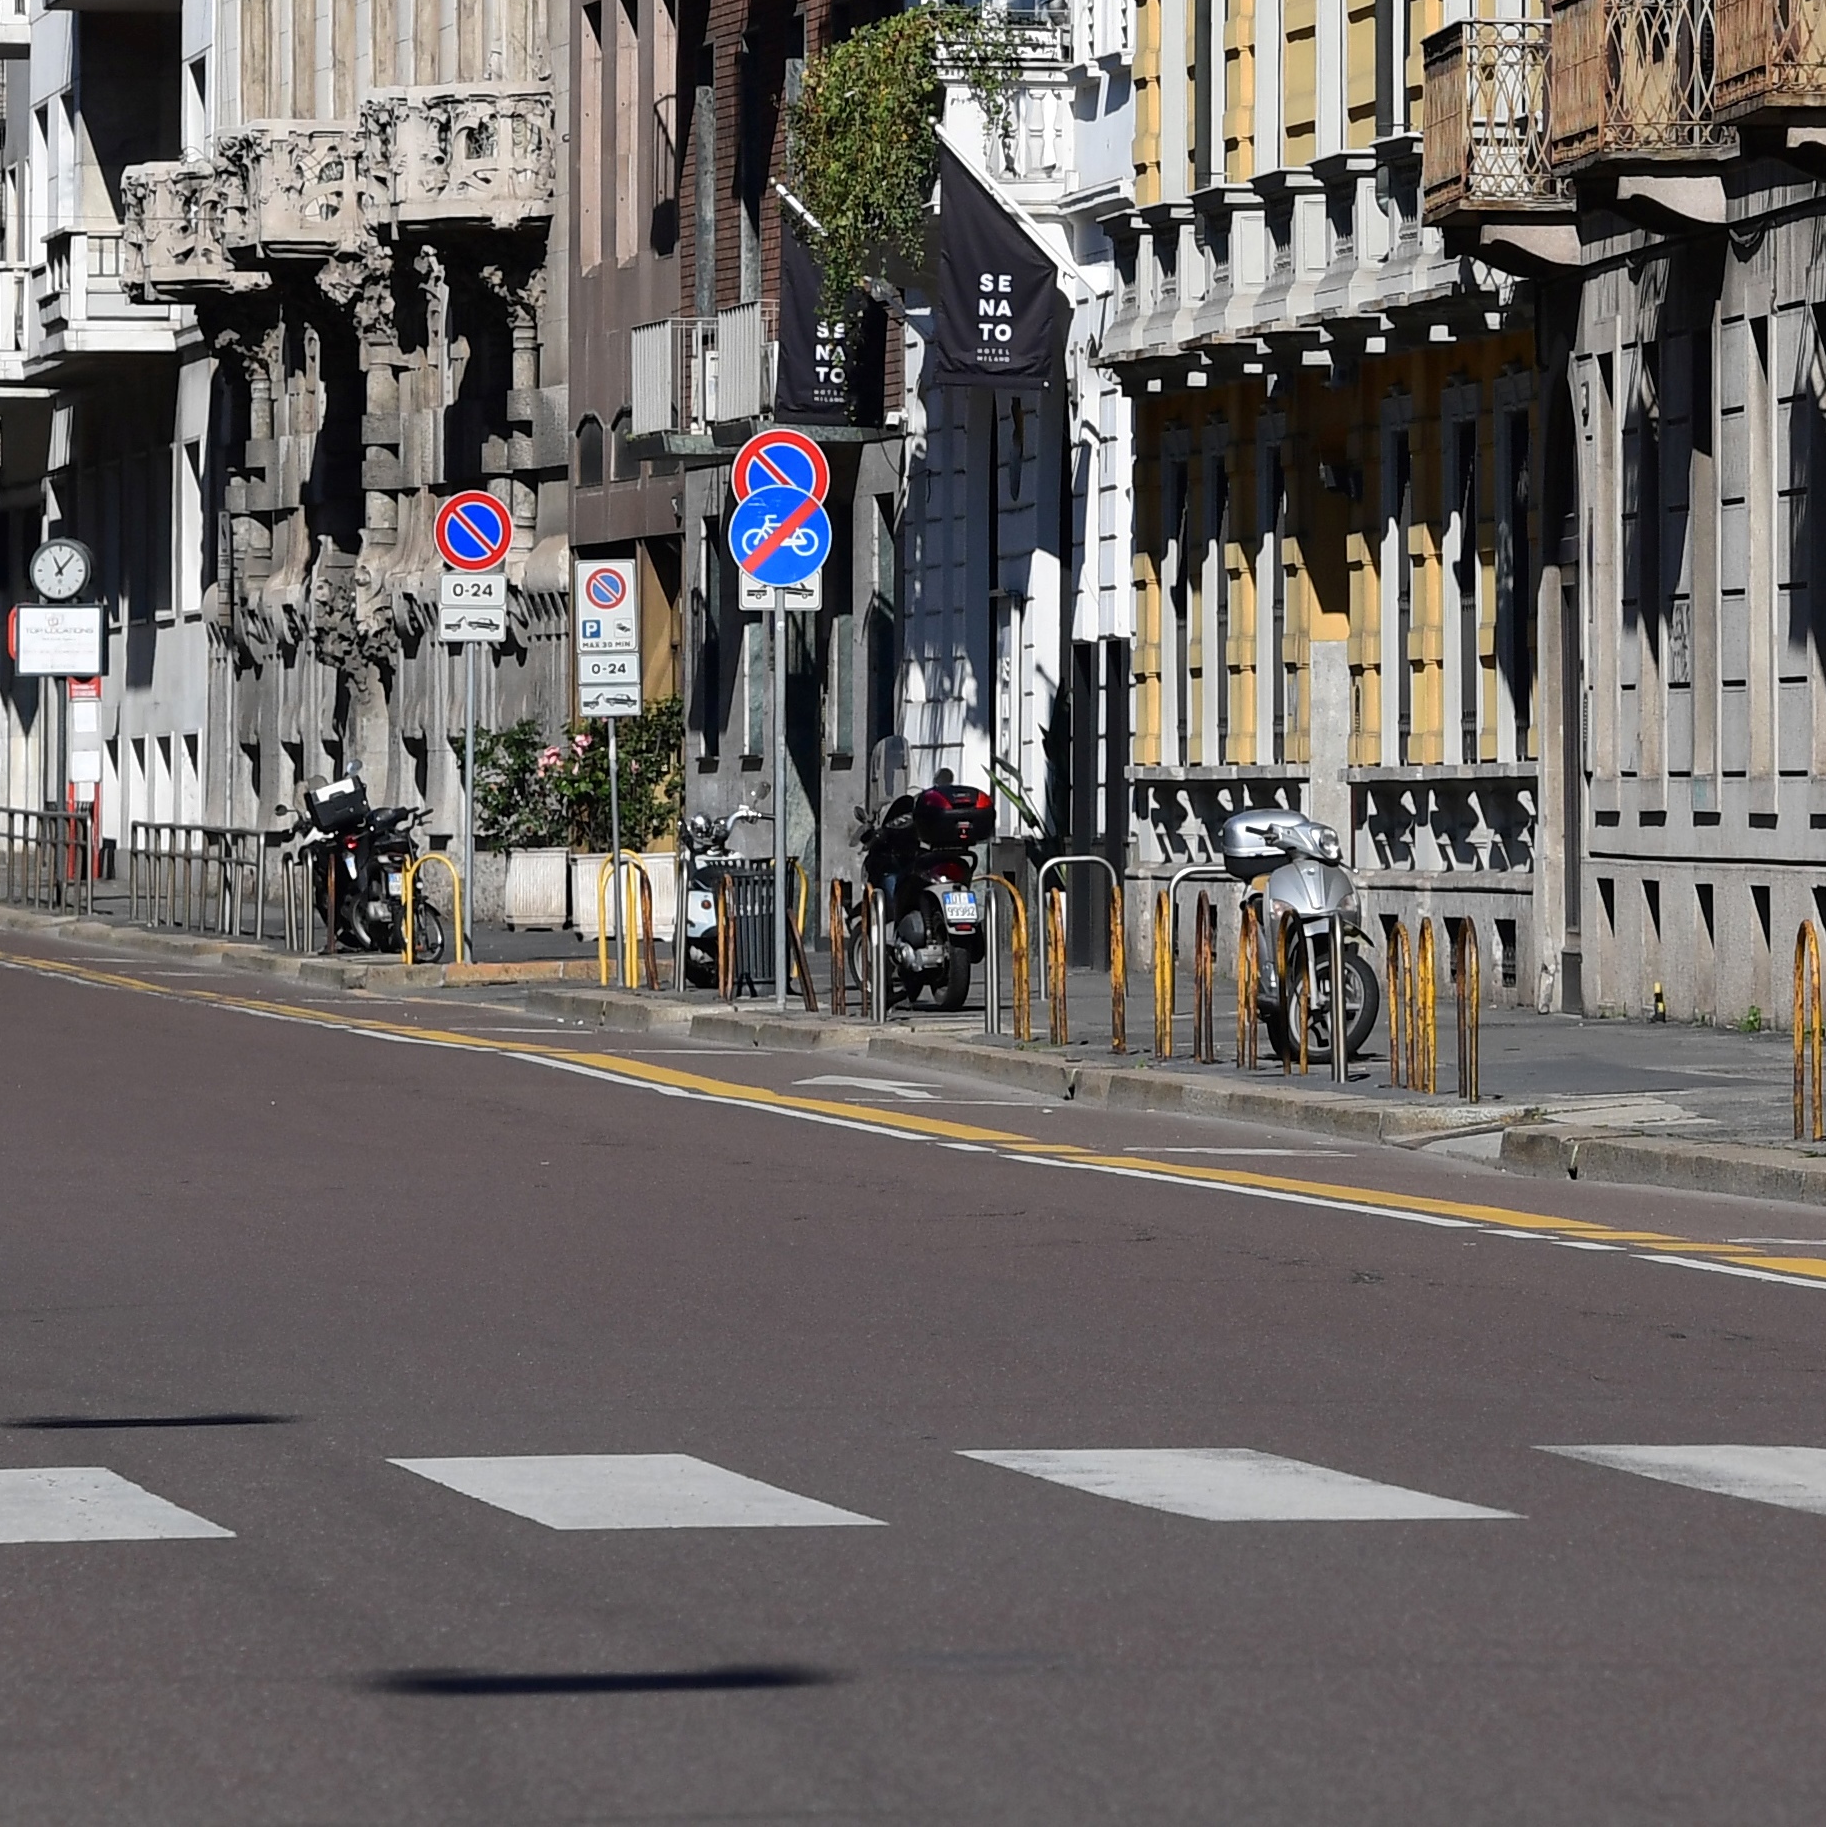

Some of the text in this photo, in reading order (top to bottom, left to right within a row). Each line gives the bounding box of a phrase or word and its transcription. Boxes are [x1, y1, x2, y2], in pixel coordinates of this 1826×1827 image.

[979, 273, 1012, 292] SE
[978, 299, 1013, 317] NA
[816, 321, 845, 339] SE
[978, 323, 1012, 342] TO
[815, 344, 846, 361] NA
[815, 367, 846, 384] TO
[453, 583, 493, 597] 0-24
[591, 663, 627, 675] 0-24
